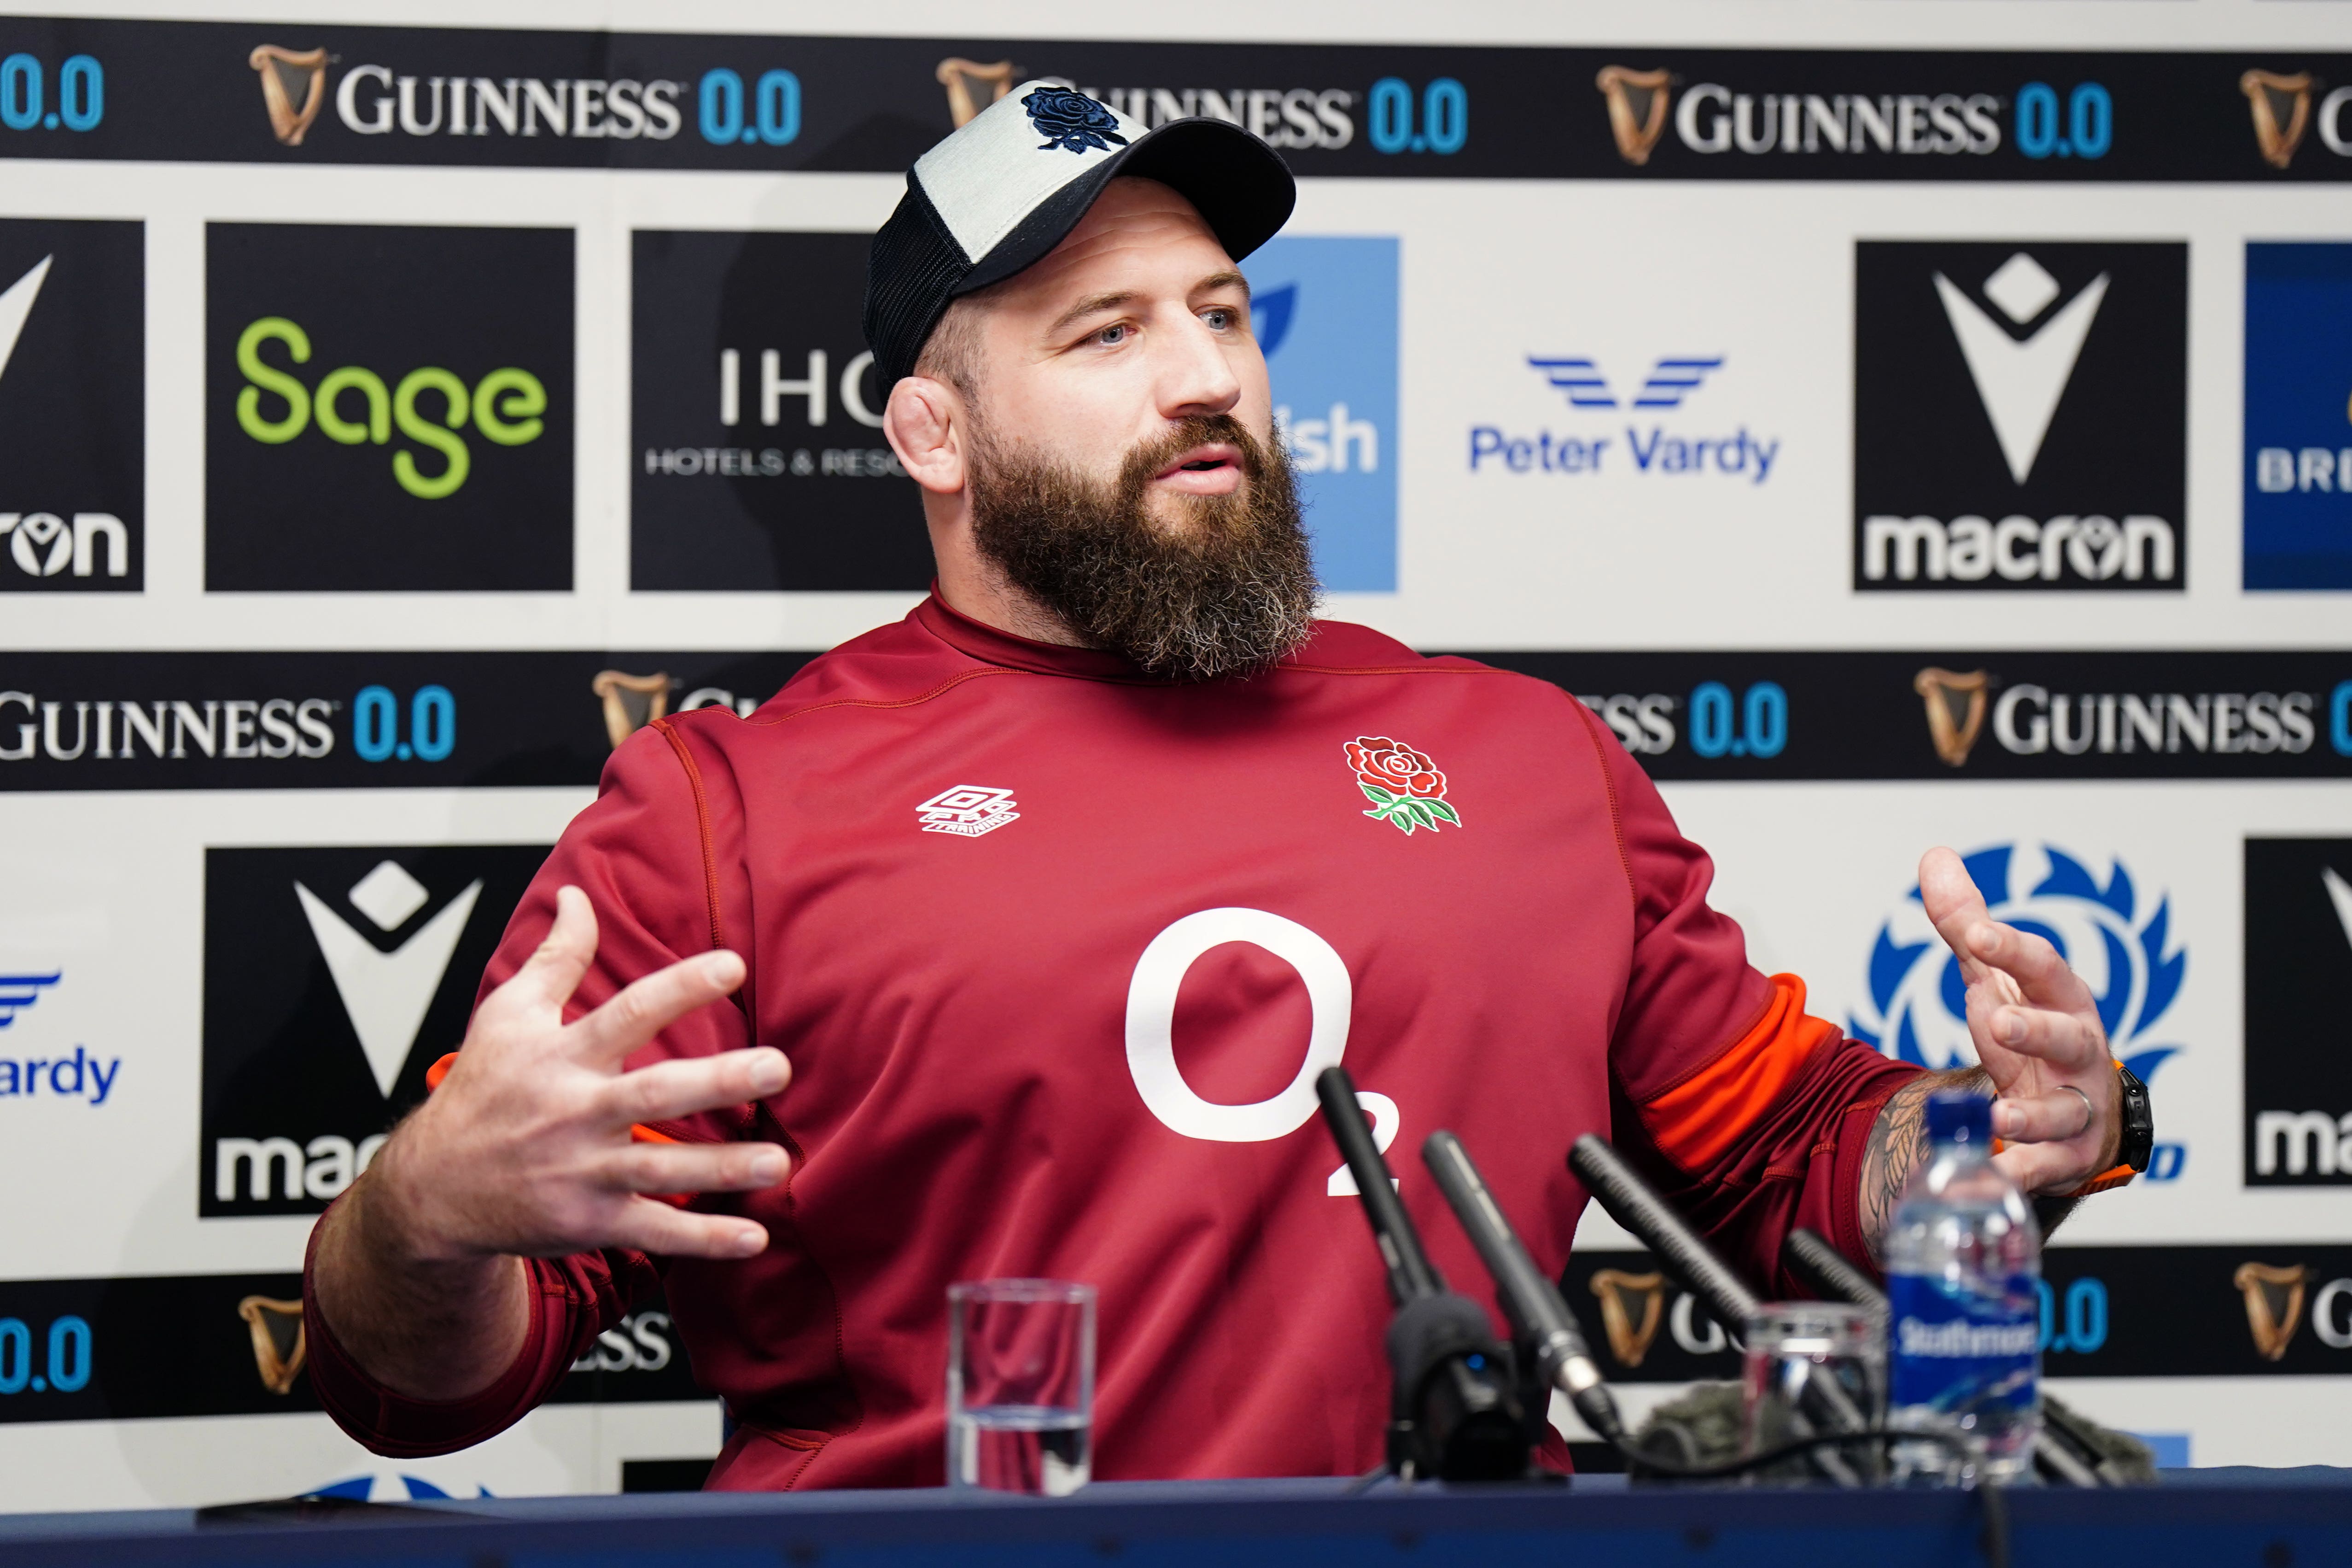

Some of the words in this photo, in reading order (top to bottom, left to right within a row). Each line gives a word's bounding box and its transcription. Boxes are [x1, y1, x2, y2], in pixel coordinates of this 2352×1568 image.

[0, 53, 105, 132] 0.0
[336, 64, 682, 140] GUINNESS
[697, 68, 802, 146] 0.0
[1367, 76, 1469, 155] 0.0
[1675, 83, 2001, 155] GUINNESS
[2014, 82, 2113, 159] 0.0
[236, 316, 548, 500] Sage
[645, 447, 785, 476] HOTELS
[790, 448, 814, 476] &
[1468, 425, 1612, 473] Peter
[1626, 425, 1780, 485] Vardy
[1863, 514, 2175, 580] macron
[0, 691, 335, 761] GUINNESS
[352, 684, 457, 763] 0.0
[1688, 681, 1789, 758] 0.0
[1993, 684, 2315, 755] GUINNESS
[935, 814, 1012, 834] TRAINING
[0, 1315, 93, 1395] 0.0
